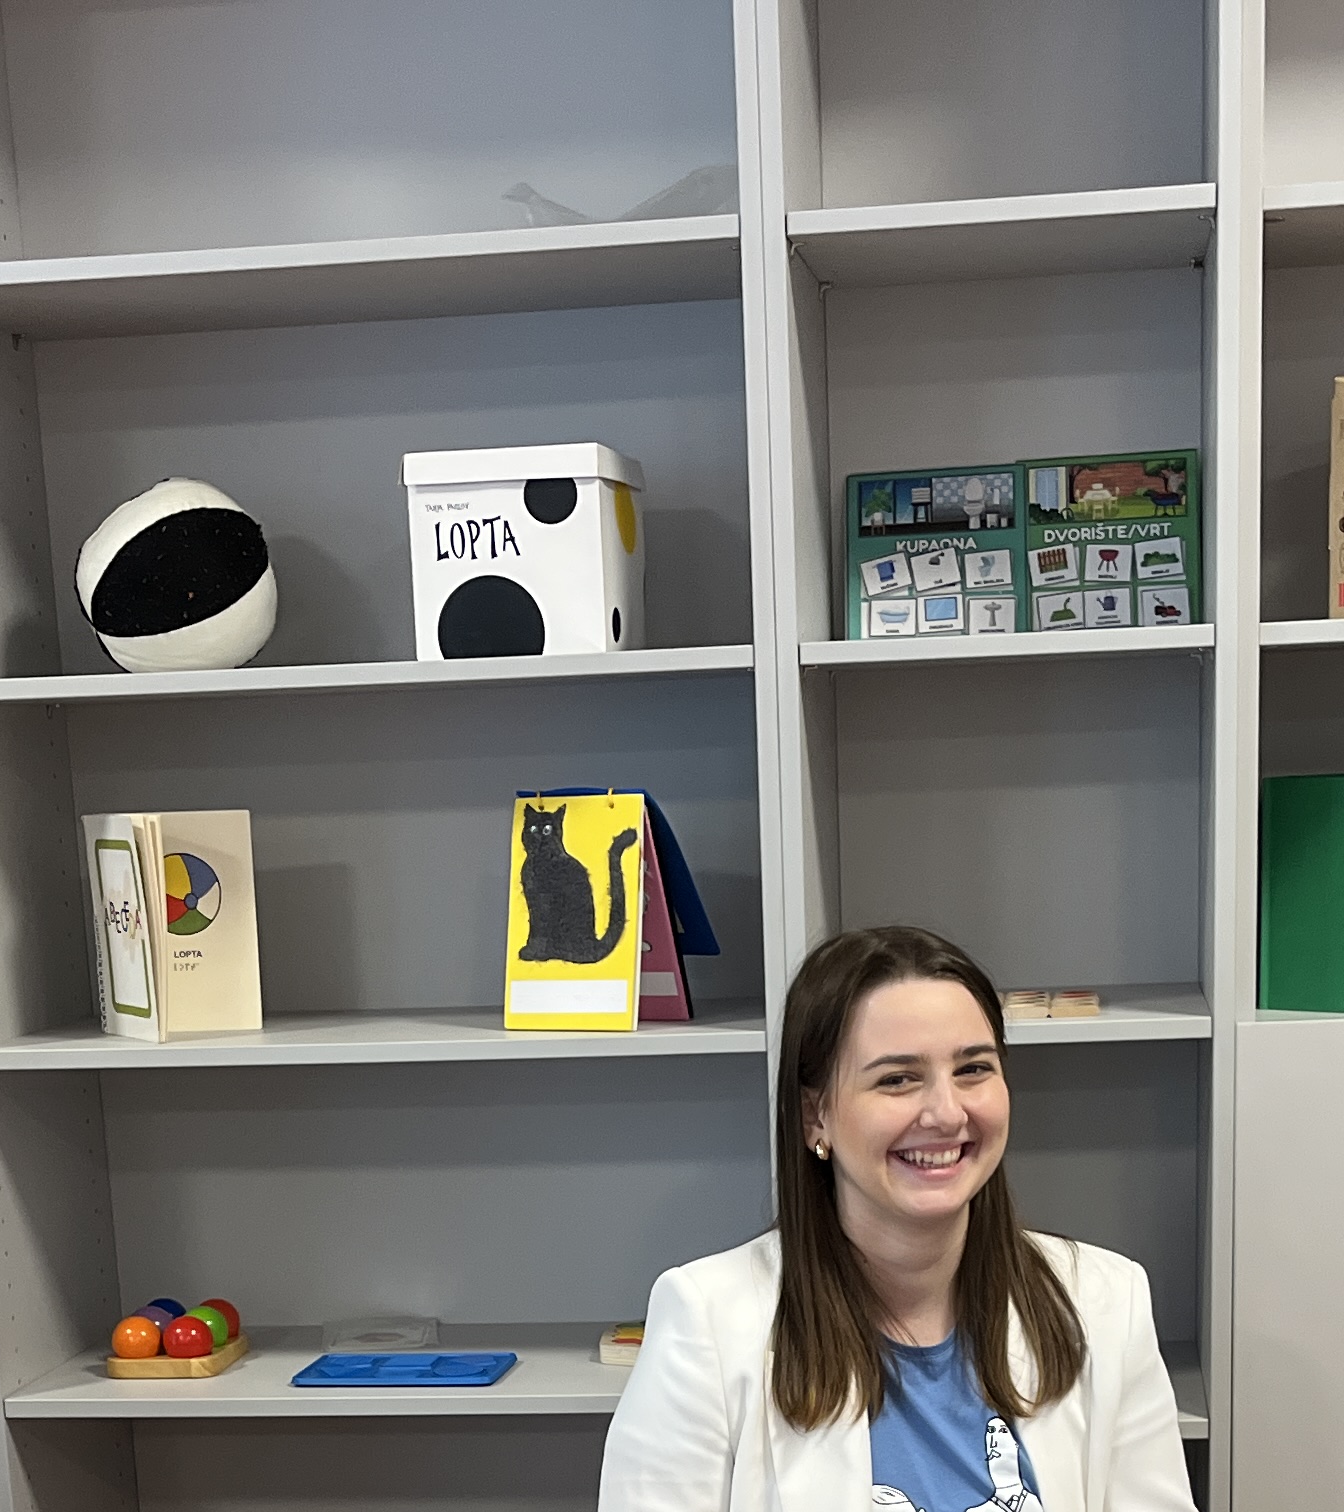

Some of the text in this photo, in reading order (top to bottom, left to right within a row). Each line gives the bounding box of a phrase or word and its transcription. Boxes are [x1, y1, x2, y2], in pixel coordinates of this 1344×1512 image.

[434, 515, 521, 561] LOPTA
[1044, 522, 1171, 543] DVORIŠTE/VRT
[896, 537, 977, 552] KUPAONA
[173, 950, 203, 959] LOPTA
